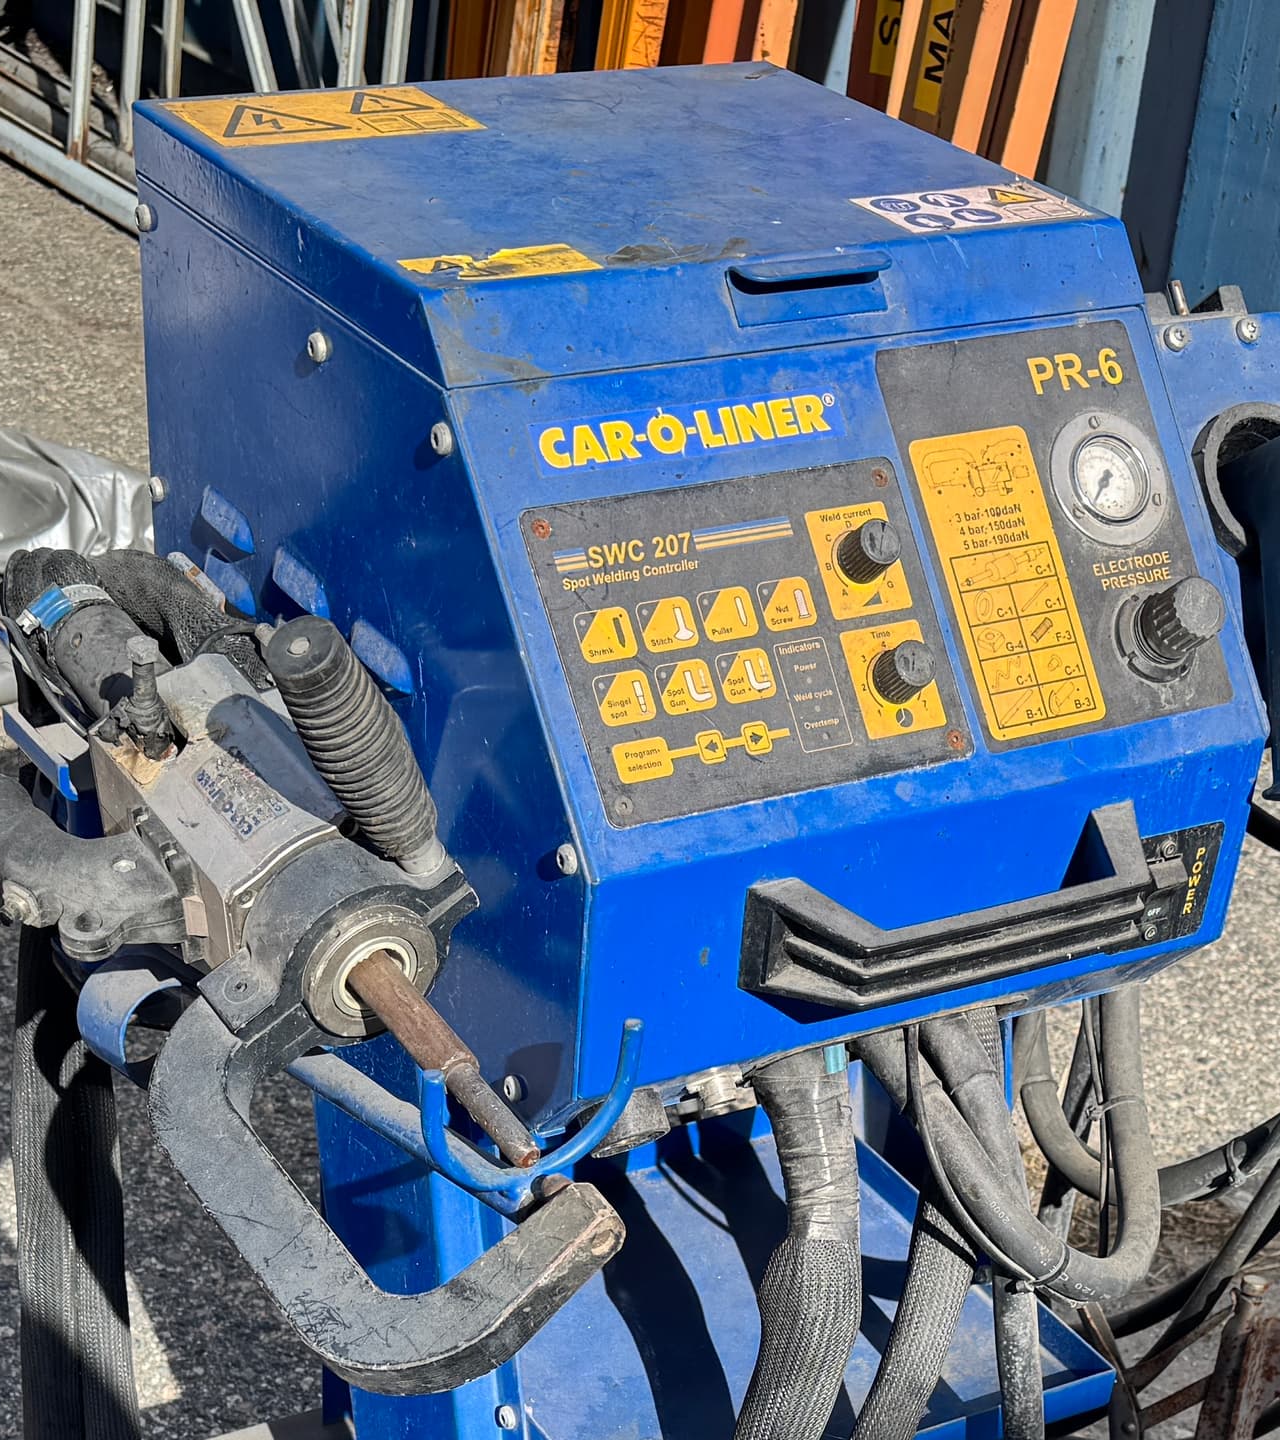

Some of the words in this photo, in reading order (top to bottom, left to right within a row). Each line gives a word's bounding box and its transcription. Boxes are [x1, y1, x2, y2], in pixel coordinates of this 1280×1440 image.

[1026, 348, 1123, 395] PR-6
[820, 511, 841, 523] Weld
[843, 508, 872, 520] current
[955, 513, 962, 523] 3
[960, 526, 966, 536] 4
[825, 534, 832, 542] C
[587, 538, 646, 569] SWC
[652, 532, 692, 557] 207
[963, 540, 970, 550] 5
[826, 563, 832, 571] B
[1035, 563, 1053, 576] C-1
[1092, 551, 1172, 577] ELECTRODE
[562, 576, 591, 592] Spot
[593, 568, 641, 588] Welding
[643, 560, 700, 580] Controller
[1101, 568, 1172, 591] PRESSURE
[841, 588, 849, 597] A
[1045, 597, 1062, 610] C-1
[776, 605, 789, 614] Nut
[997, 605, 1014, 618] C-1
[770, 617, 793, 626] Screw
[870, 630, 890, 639] Time
[1055, 630, 1072, 642] F-3
[778, 642, 821, 655] Indicators
[1006, 640, 1024, 651] G-4
[861, 655, 867, 664] 3
[793, 663, 817, 673] Power
[1064, 663, 1081, 676] C-1
[727, 677, 745, 686] Spot
[1016, 673, 1033, 685] C-1
[666, 688, 685, 697] Spot
[862, 684, 868, 692] 2
[793, 692, 813, 702] Weld
[670, 700, 686, 708] Gun
[1074, 697, 1092, 710] B-3
[610, 710, 628, 719] spot
[1025, 707, 1043, 720] B-1
[804, 718, 840, 730] Overtemp
[628, 760, 662, 772] selection
[1183, 847, 1206, 915] POWER
[1147, 907, 1162, 916] OFF
